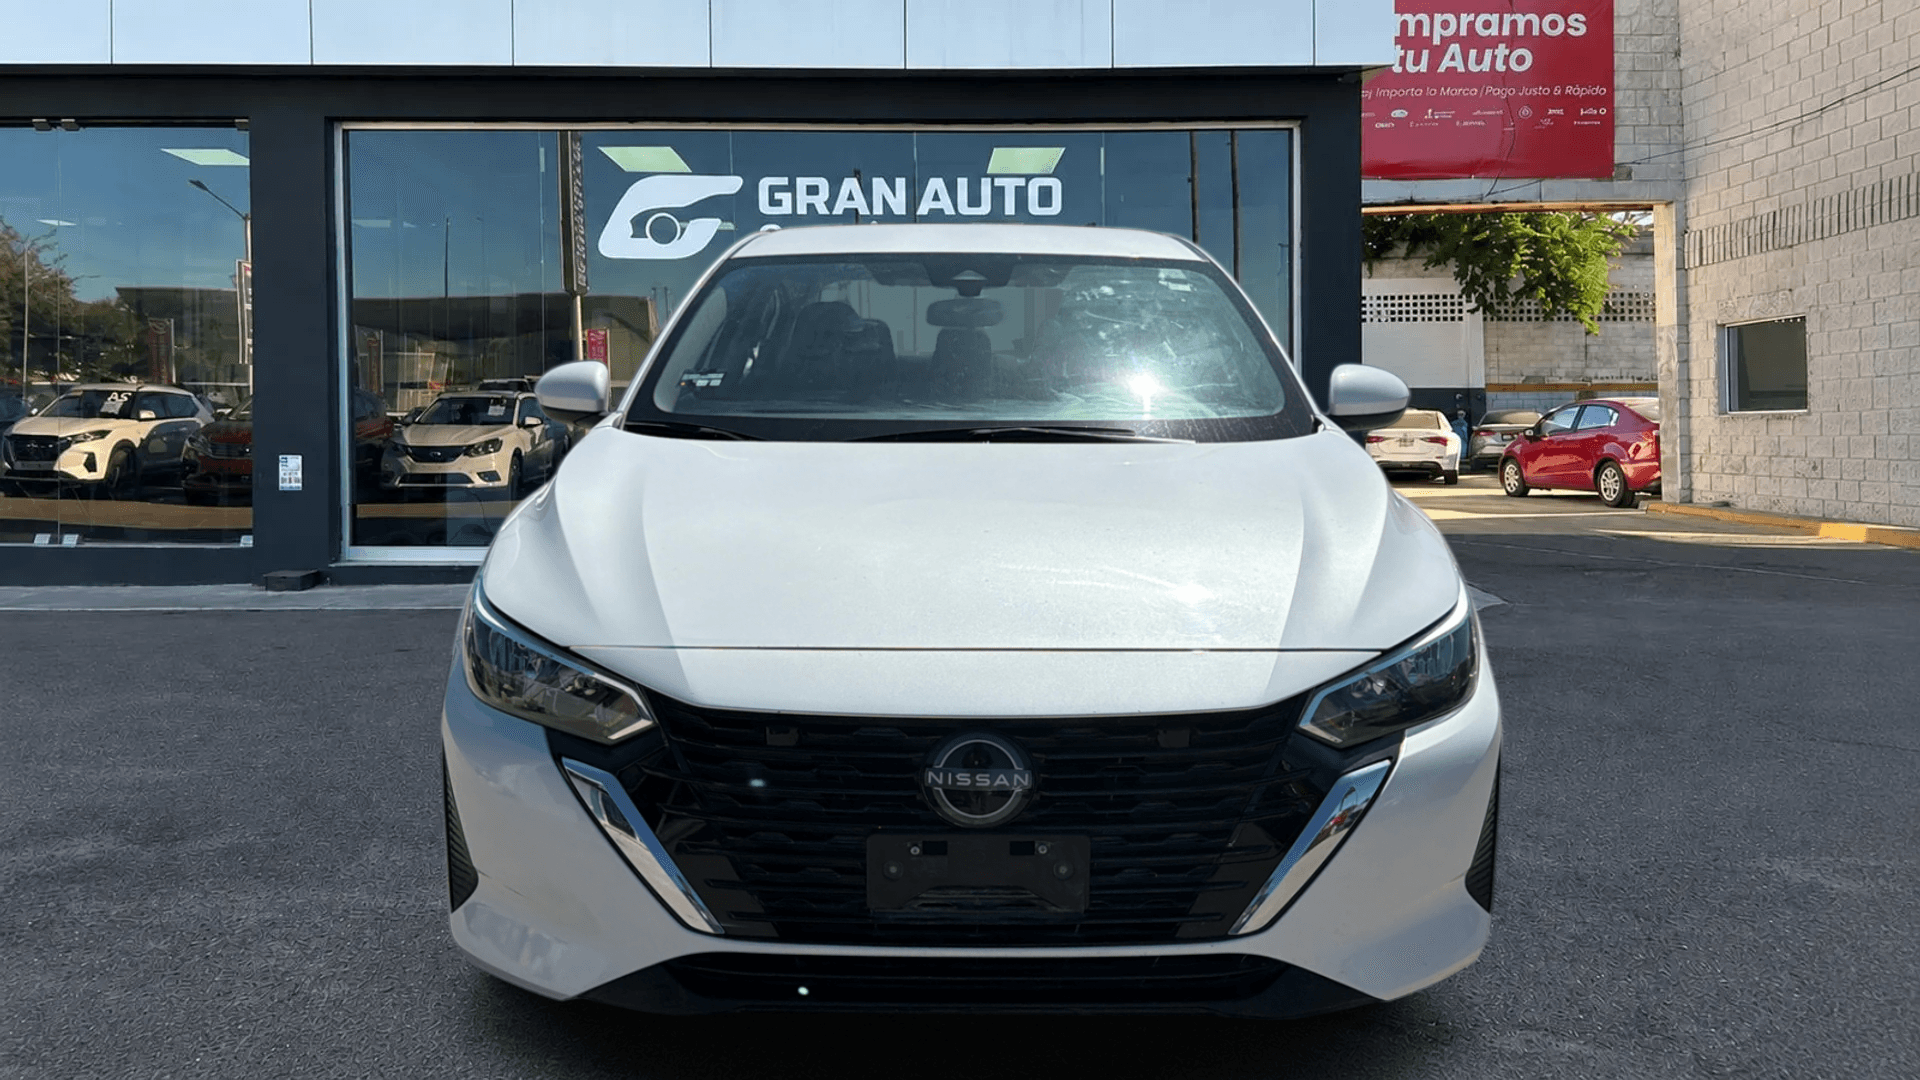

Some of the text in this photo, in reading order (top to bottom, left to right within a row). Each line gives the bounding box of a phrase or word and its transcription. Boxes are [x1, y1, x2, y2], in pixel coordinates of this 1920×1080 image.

[1395, 12, 1587, 46] mpramos
[1392, 43, 1534, 73] tu Auto
[1519, 85, 1551, 96] Justo
[1553, 85, 1562, 96] &
[758, 176, 1063, 216] GRAN AUTO
[927, 770, 1030, 788] NISSAN
